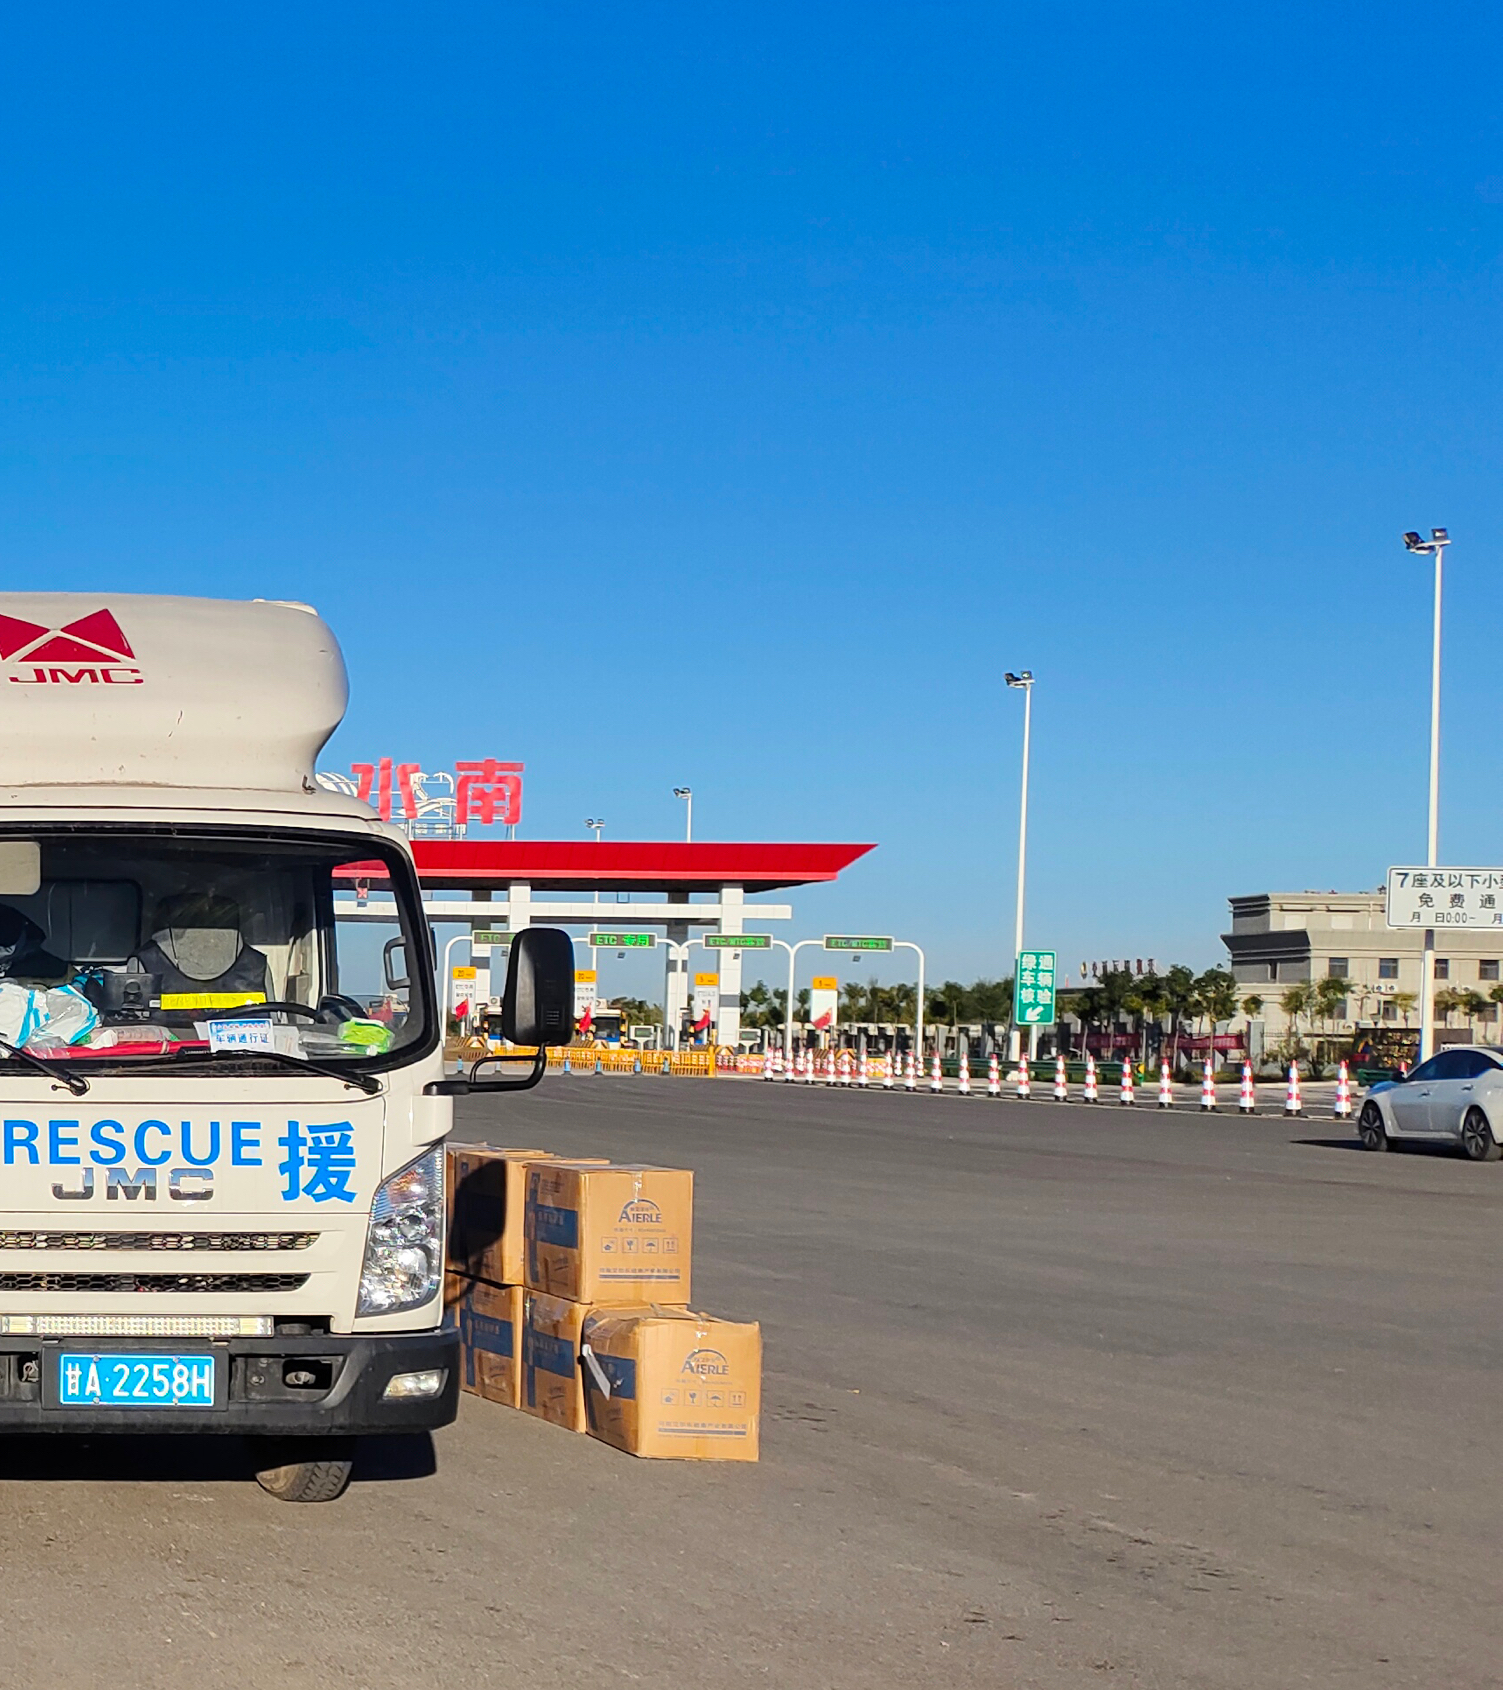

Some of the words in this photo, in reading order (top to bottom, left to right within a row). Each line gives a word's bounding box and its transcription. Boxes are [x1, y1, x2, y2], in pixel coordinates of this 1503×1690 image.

[8, 668, 144, 683] JMC
[596, 935, 617, 945] ETC
[1021, 954, 1053, 970] 绿通
[1020, 970, 1053, 987] 车辆
[216, 1032, 270, 1044] 车辆通行证
[3, 1120, 263, 1167] RESCUE
[278, 1119, 358, 1203] 援
[51, 1167, 215, 1200] JMC
[618, 1210, 662, 1223] AIERLE
[681, 1360, 729, 1375] AIERLE
